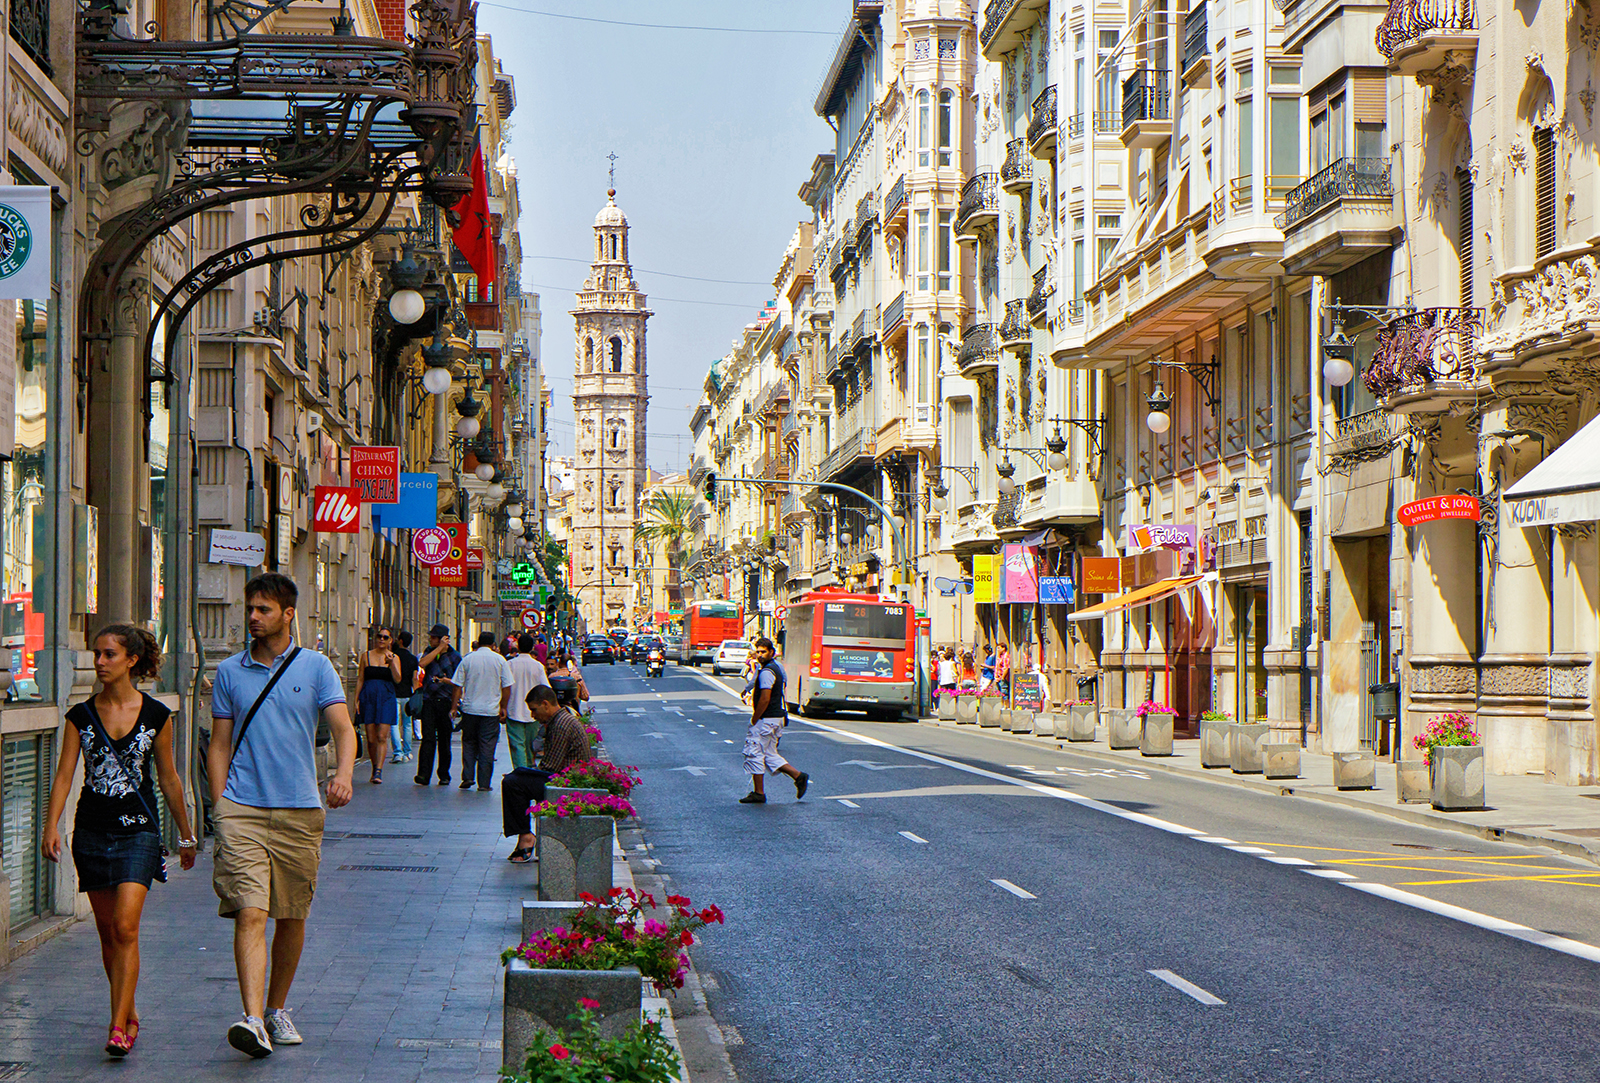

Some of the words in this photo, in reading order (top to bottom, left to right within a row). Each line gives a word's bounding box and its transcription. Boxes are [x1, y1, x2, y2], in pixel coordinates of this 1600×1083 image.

[353, 449, 395, 463] RESTAURANTE
[357, 465, 392, 476] CHINO
[377, 478, 395, 499] HUA
[316, 492, 358, 529] illy
[1402, 500, 1437, 516] OUTLET
[1439, 497, 1451, 510] &
[1452, 498, 1474, 510] JOYA
[1511, 499, 1547, 523] KUONI
[1411, 513, 1436, 524] JOYERIA
[1440, 510, 1472, 518] JEWELLERY
[1149, 527, 1189, 544] Folder
[418, 550, 446, 562] valencia
[433, 564, 463, 576] nest
[854, 608, 866, 617] 26
[884, 607, 904, 616] 7083
